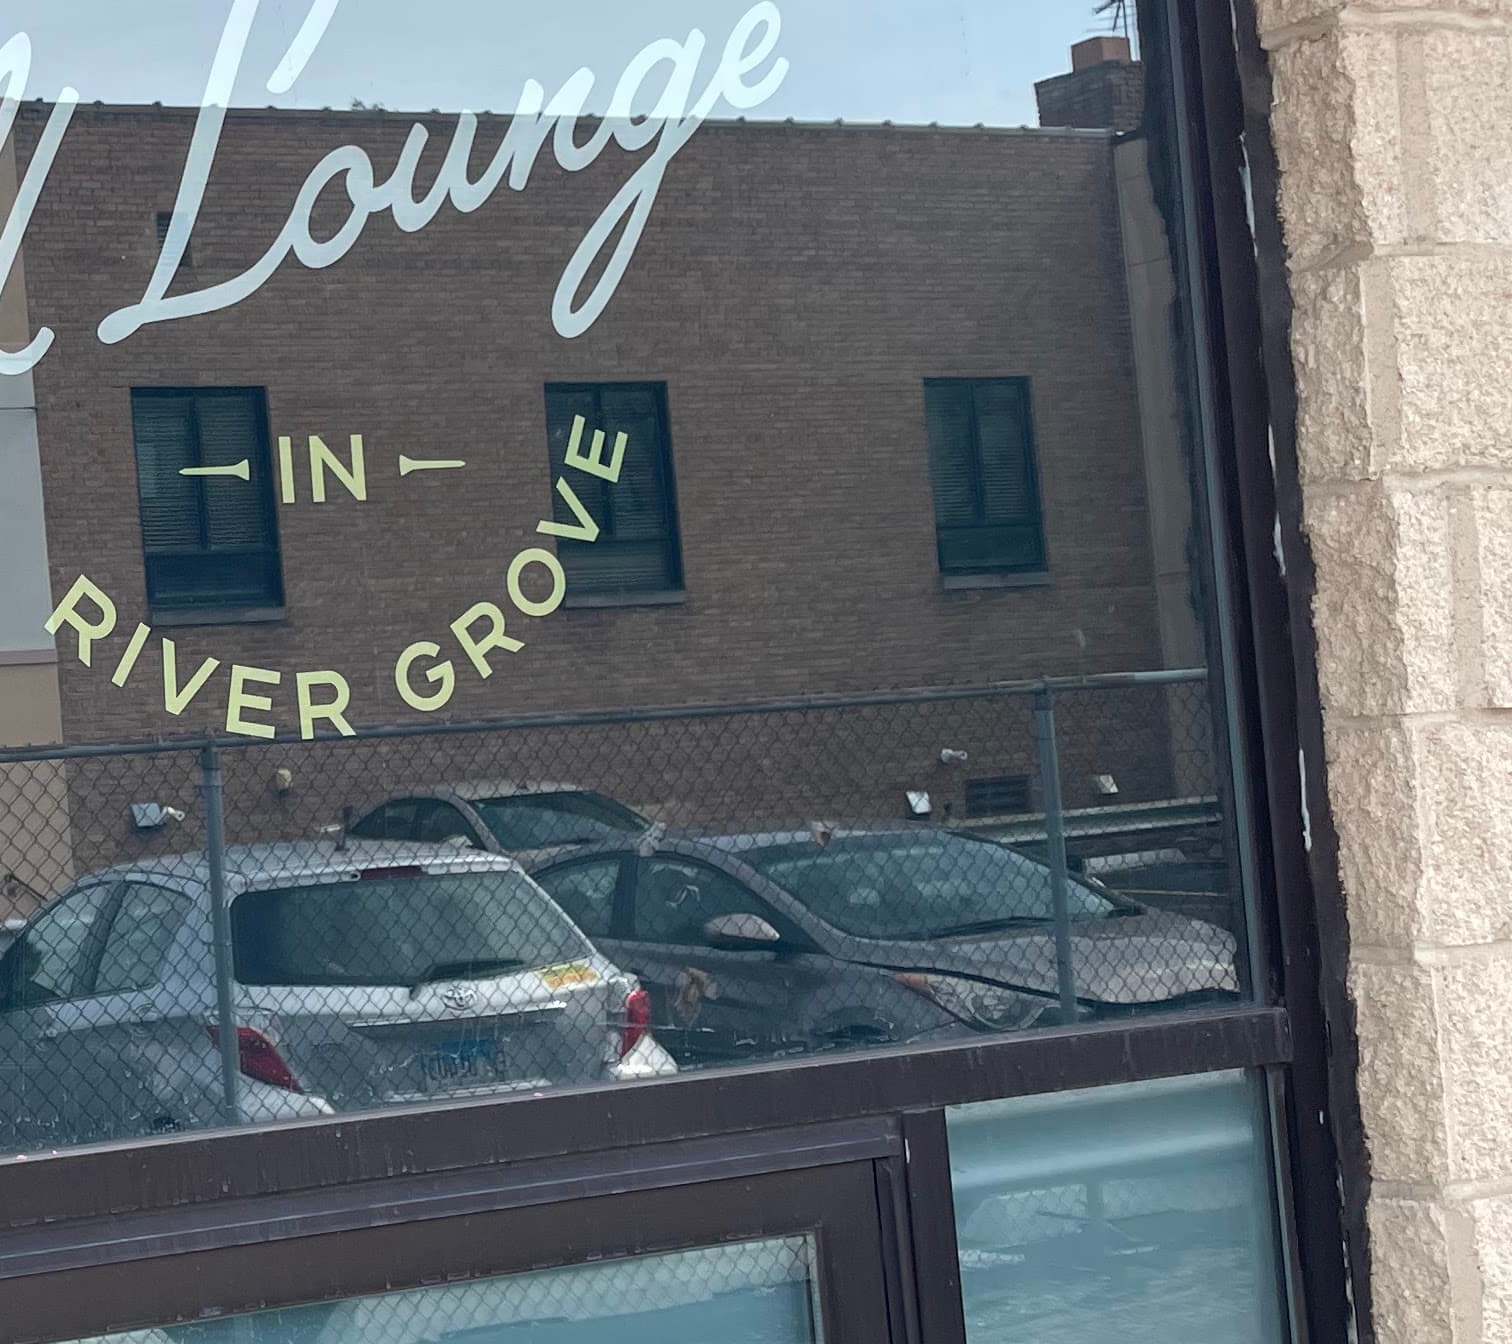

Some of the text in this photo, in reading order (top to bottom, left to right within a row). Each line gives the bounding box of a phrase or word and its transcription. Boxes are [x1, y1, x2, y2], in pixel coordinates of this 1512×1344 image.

[279, 434, 366, 504] IN
[44, 414, 628, 740] RIVER GROVE
